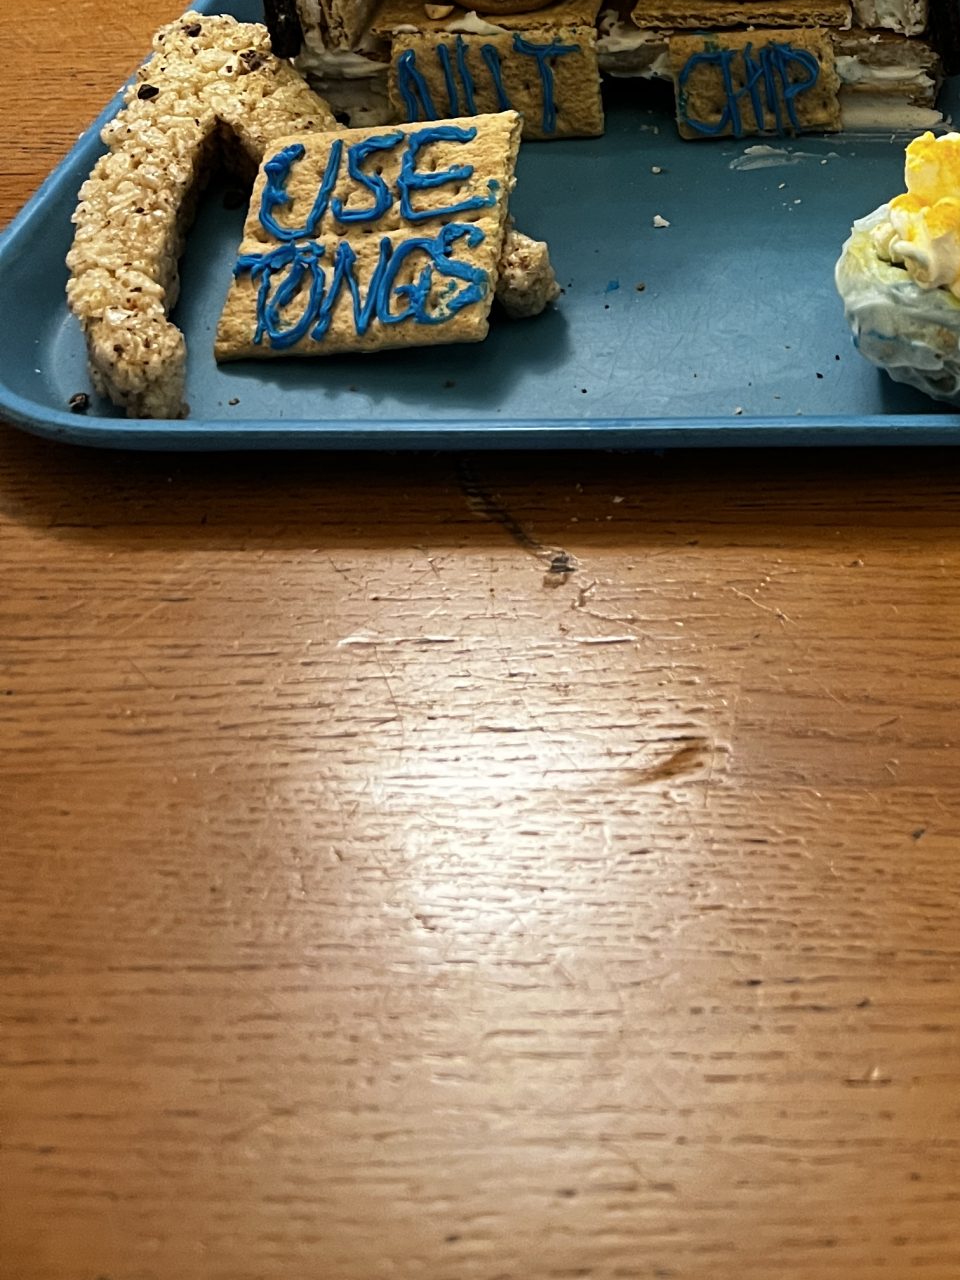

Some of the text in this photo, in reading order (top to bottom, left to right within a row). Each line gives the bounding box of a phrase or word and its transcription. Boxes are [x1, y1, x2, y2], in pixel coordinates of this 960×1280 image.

[399, 32, 582, 134] NUT
[259, 125, 499, 242] USE
[233, 222, 491, 350] TONGS
